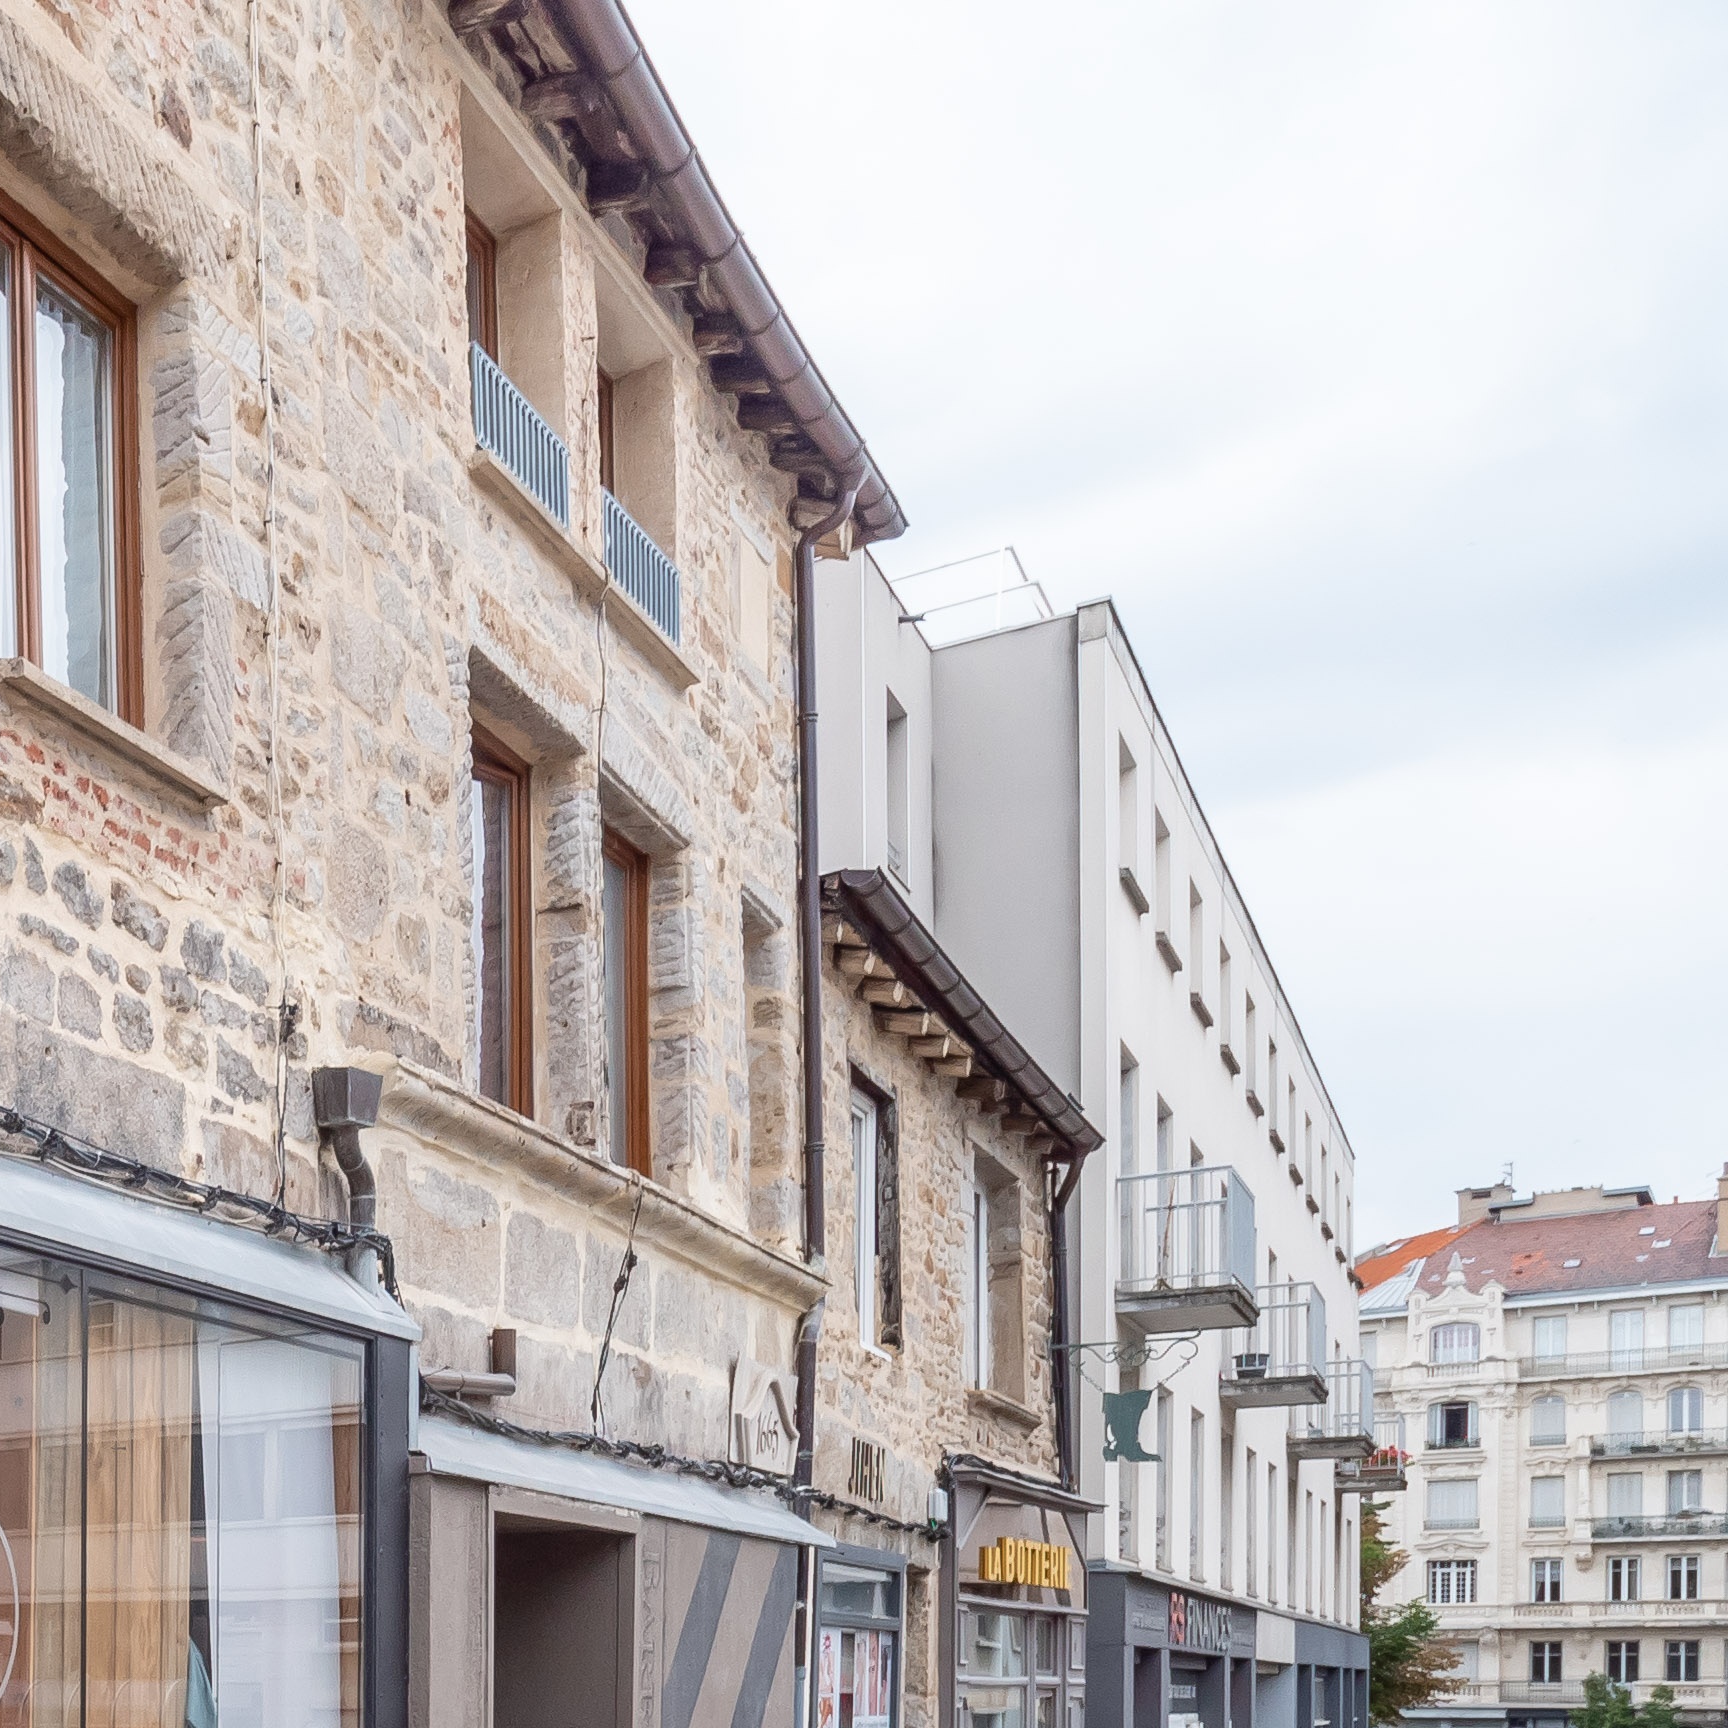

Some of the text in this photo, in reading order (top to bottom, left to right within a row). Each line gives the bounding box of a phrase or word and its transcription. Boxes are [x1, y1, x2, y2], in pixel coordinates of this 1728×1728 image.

[756, 1411, 779, 1461] 1665
[988, 1536, 1073, 1590] LA BOTTERIE
[1186, 1597, 1232, 1654] FINANCES
